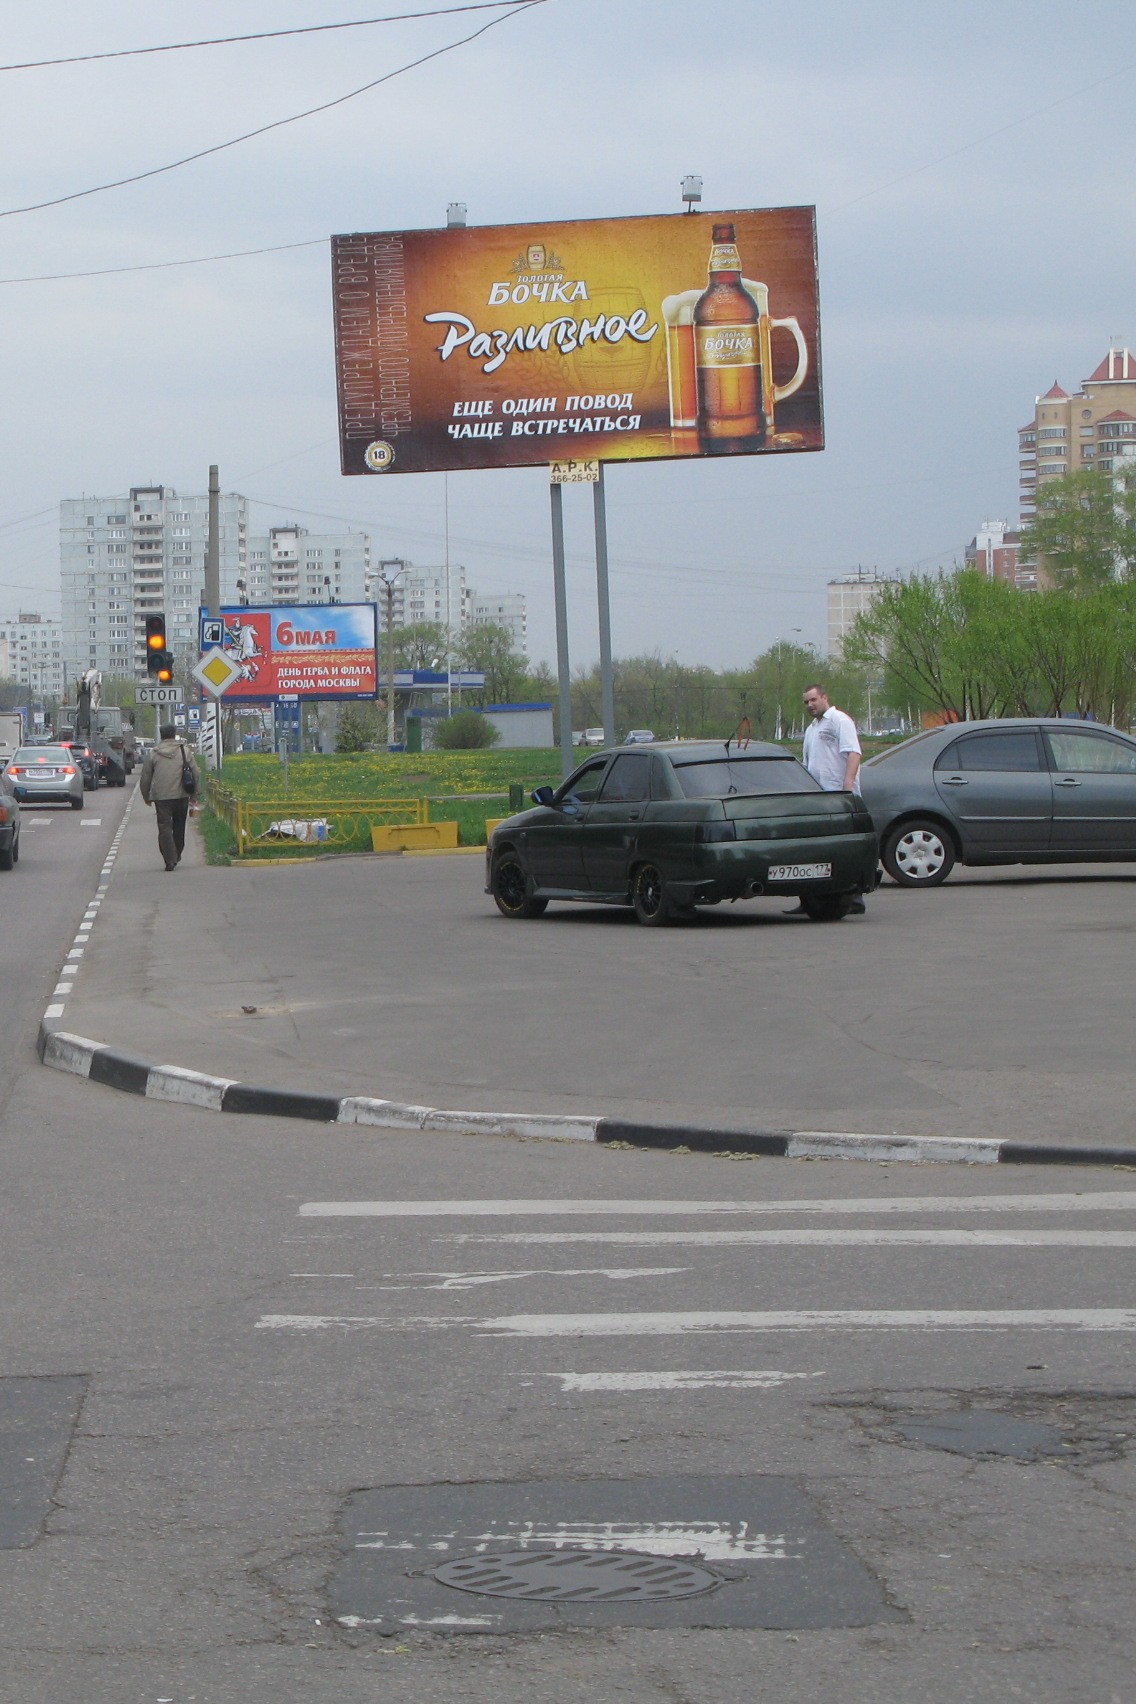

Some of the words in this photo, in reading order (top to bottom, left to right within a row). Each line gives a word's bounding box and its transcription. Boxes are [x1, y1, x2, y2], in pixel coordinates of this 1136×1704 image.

[337, 237, 374, 284] ВРЕДЕ
[373, 236, 404, 266] ПИВА
[516, 273, 564, 283] ЗОЛОТАЯ
[339, 291, 370, 300] О
[487, 280, 590, 306] БОЧКА
[375, 268, 409, 355] УПОТРЕБЛЕНИЯ
[424, 308, 659, 374] Разливное
[704, 338, 753, 350] БОЧКА
[340, 307, 380, 440] ПРЕДУПРЕЖДАЕМ
[378, 357, 412, 438] ЧРЕЗМЕРНОГО
[452, 400, 494, 418] ЕЩЕ
[501, 397, 557, 416] ОДИН
[564, 393, 634, 411] ПОВОД
[447, 421, 504, 440] ЧАЩЕ
[510, 414, 642, 436] ВСТРЕЧАТЬСЯ
[373, 451, 386, 460] 18
[550, 474, 598, 484] 366-25-02
[276, 621, 294, 646] 6
[295, 630, 336, 646] МАЯ
[277, 667, 301, 678] ДЕНЬ
[303, 667, 329, 676] ГЕРБА
[331, 667, 339, 675] И
[340, 666, 372, 675] ФЛАГА
[278, 679, 316, 689] ГОРОДА
[317, 678, 360, 688] МОСКВЫ
[139, 690, 177, 702] СТОП
